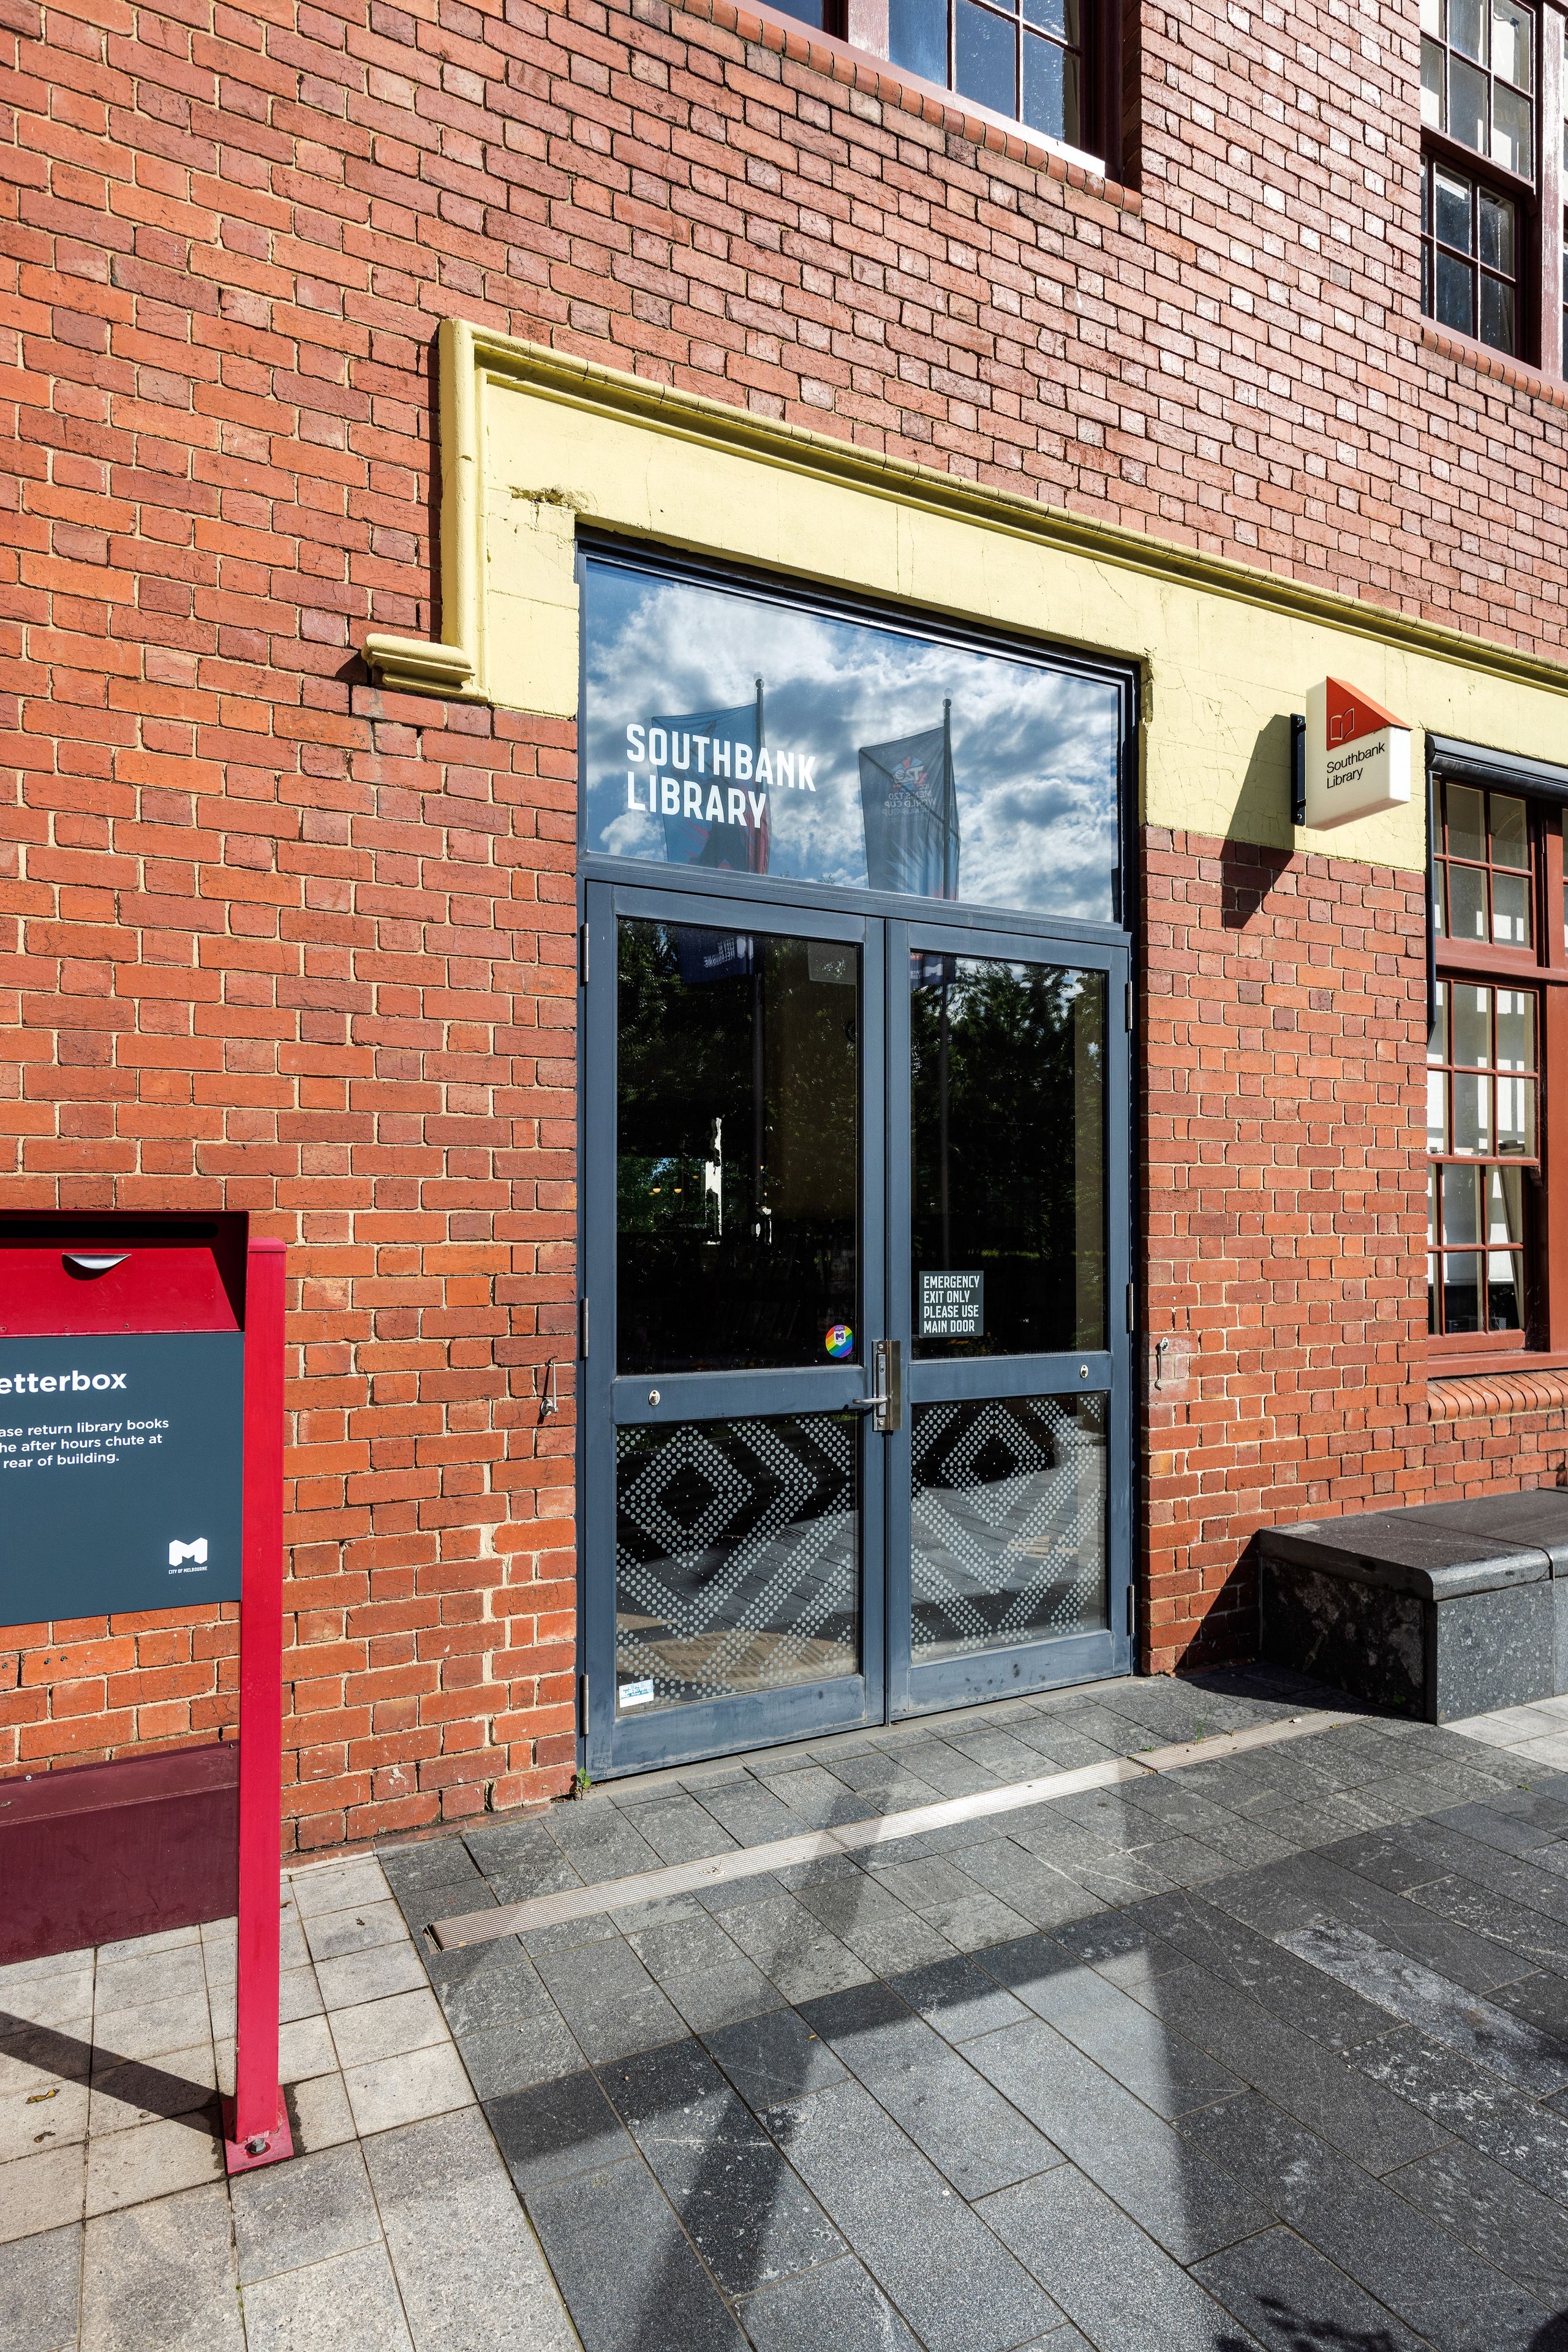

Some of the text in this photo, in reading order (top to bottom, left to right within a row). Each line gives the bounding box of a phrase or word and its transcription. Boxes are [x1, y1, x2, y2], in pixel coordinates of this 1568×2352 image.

[625, 723, 816, 791] SOUTHBANK
[1326, 742, 1385, 774] Southbank
[1326, 767, 1363, 789] Library
[626, 771, 766, 828] LIBRARY
[924, 1275, 980, 1289] EMERGENCY
[924, 1290, 970, 1303] EXIT ONLY
[924, 1305, 979, 1318] PLEASE USE
[924, 1319, 975, 1333] MAIN DOOR
[0, 1370, 127, 1395] etterbox
[28, 1424, 72, 1436] return
[77, 1422, 123, 1433] library
[127, 1418, 169, 1430] books
[21, 1440, 56, 1452] after
[61, 1438, 101, 1450] hours
[105, 1435, 145, 1447] chute
[148, 1433, 163, 1444] at
[3, 1452, 119, 1469] rear of building.
